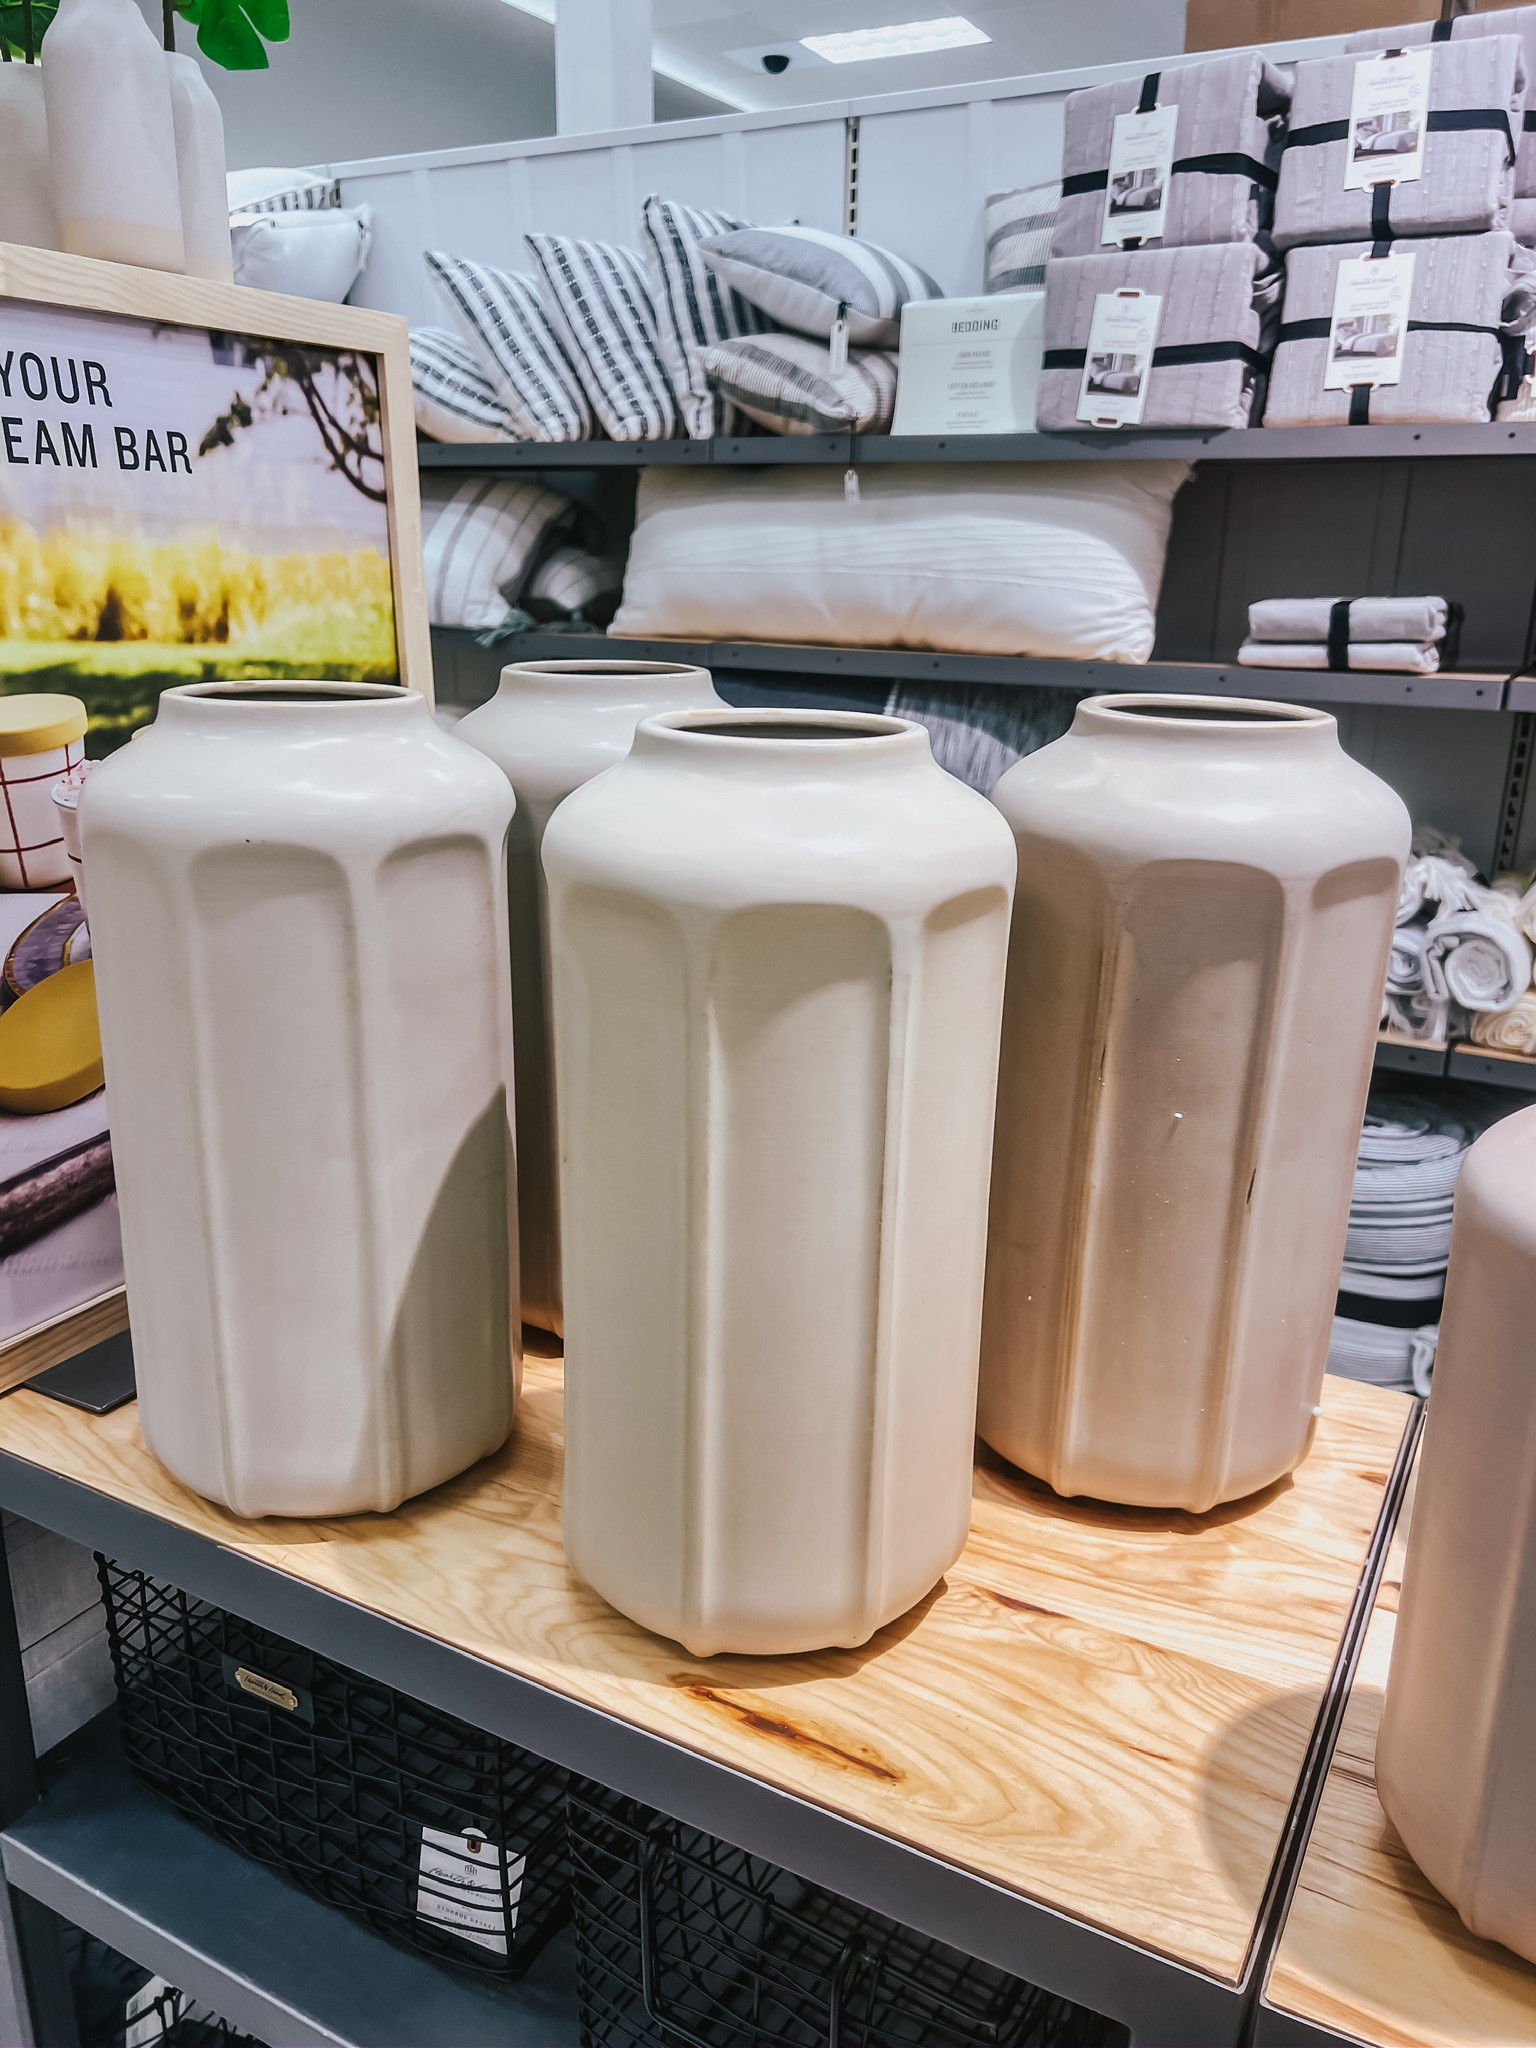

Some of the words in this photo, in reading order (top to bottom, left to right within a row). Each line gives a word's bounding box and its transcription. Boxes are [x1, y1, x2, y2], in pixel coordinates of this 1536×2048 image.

[951, 318, 999, 333] BEDDING
[0, 350, 113, 407] YOUR
[114, 426, 193, 475] BAR
[436, 1903, 467, 1920] STORAGE
